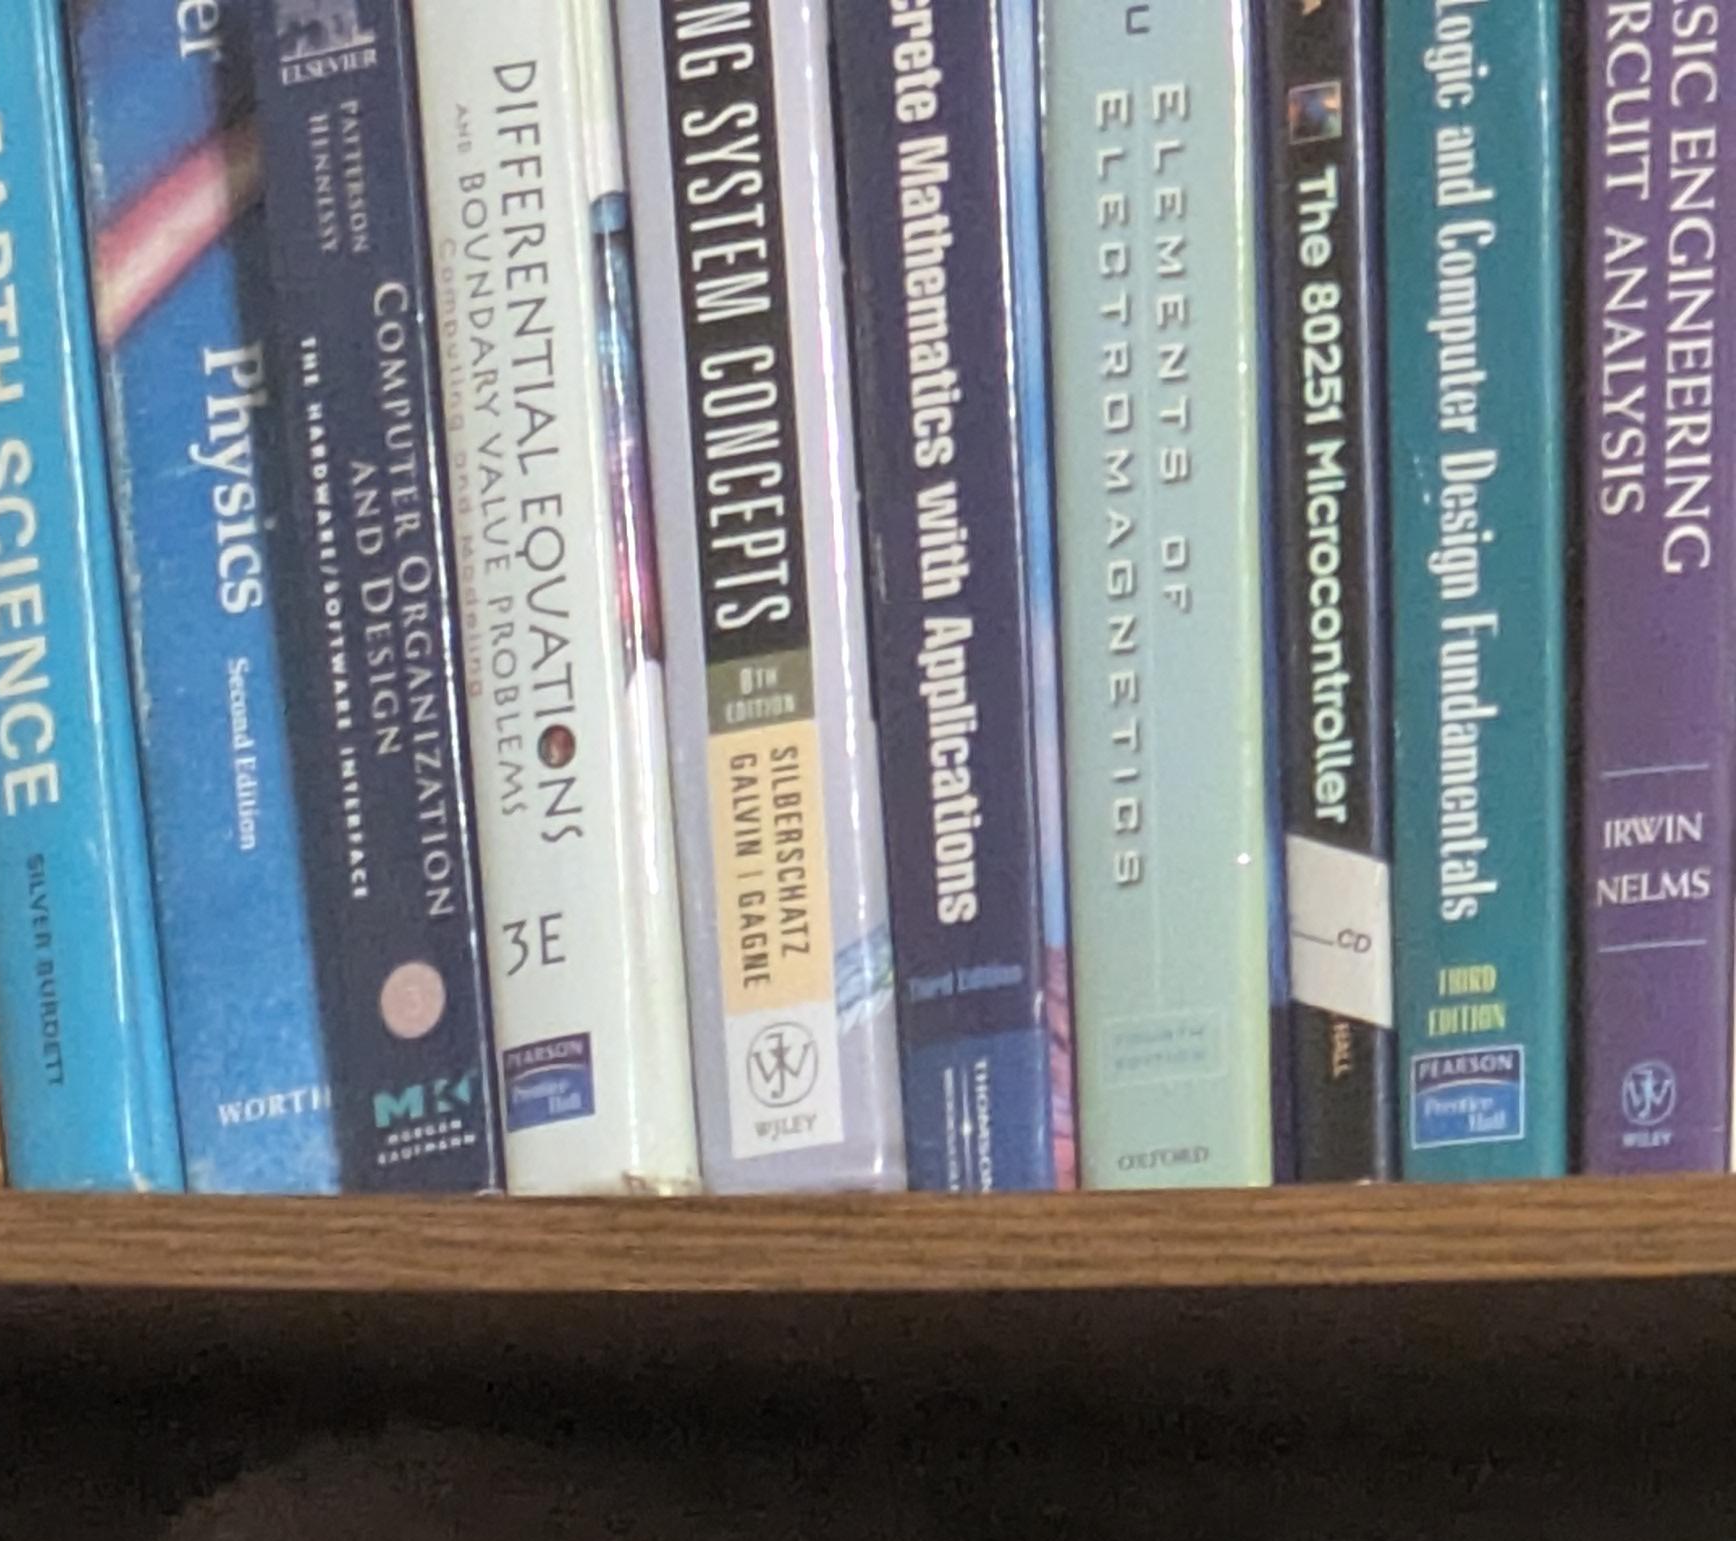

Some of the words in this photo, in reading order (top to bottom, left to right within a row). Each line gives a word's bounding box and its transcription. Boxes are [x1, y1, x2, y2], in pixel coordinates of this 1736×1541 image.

[279, 48, 378, 86] ELSEVIER
[341, 100, 370, 254] PATTERSON
[681, 101, 774, 326] SYSTEM
[1296, 168, 1337, 267] The
[1435, 128, 1494, 208] and
[458, 171, 501, 416] BOUNDARY
[493, 59, 560, 476] DIFFERENTIAL
[898, 135, 956, 470] Mathematics
[1152, 82, 1190, 486] ELEMENTS
[1426, 219, 1496, 433] Computer
[298, 336, 320, 390] THE
[374, 281, 425, 541] COMPUTER
[1301, 281, 1345, 426] 80251
[1599, 226, 1647, 518] ANALYSIS
[1662, 128, 1718, 576] ENGINEERING
[190, 343, 265, 616] Physics
[350, 461, 384, 557] AND
[477, 433, 512, 575] VALUE
[698, 345, 791, 632] CONCEPTS
[916, 481, 975, 601] with
[1094, 90, 1144, 889] ELECTROMAGNETICS
[1428, 448, 1500, 601] Design
[1162, 537, 1192, 613] OF
[1302, 443, 1354, 824] Microcontroller
[225, 657, 250, 740] Second
[358, 565, 402, 758] DESIGN
[485, 595, 528, 817] PROBLEMS
[517, 493, 584, 845] EQUATIONS
[724, 692, 797, 722] EDITION
[230, 742, 256, 852] Edition
[391, 556, 455, 918] ORGANIZATION
[729, 753, 763, 858] GALVIN
[916, 616, 984, 927] Applications
[1437, 612, 1500, 923] Fundamentals
[770, 745, 811, 958] SILBERSCHATZ
[1596, 866, 1712, 908] NELMS
[1603, 812, 1704, 850] IRWIN
[502, 912, 566, 976] 3E
[736, 888, 771, 991] GAGNE
[1336, 926, 1372, 956] CD
[1438, 964, 1498, 996] THIRD
[504, 1037, 584, 1073] PEARSON
[1417, 1053, 1514, 1080] PEARSON
[1427, 1000, 1507, 1037] EDITION
[217, 1086, 333, 1127] WORTH
